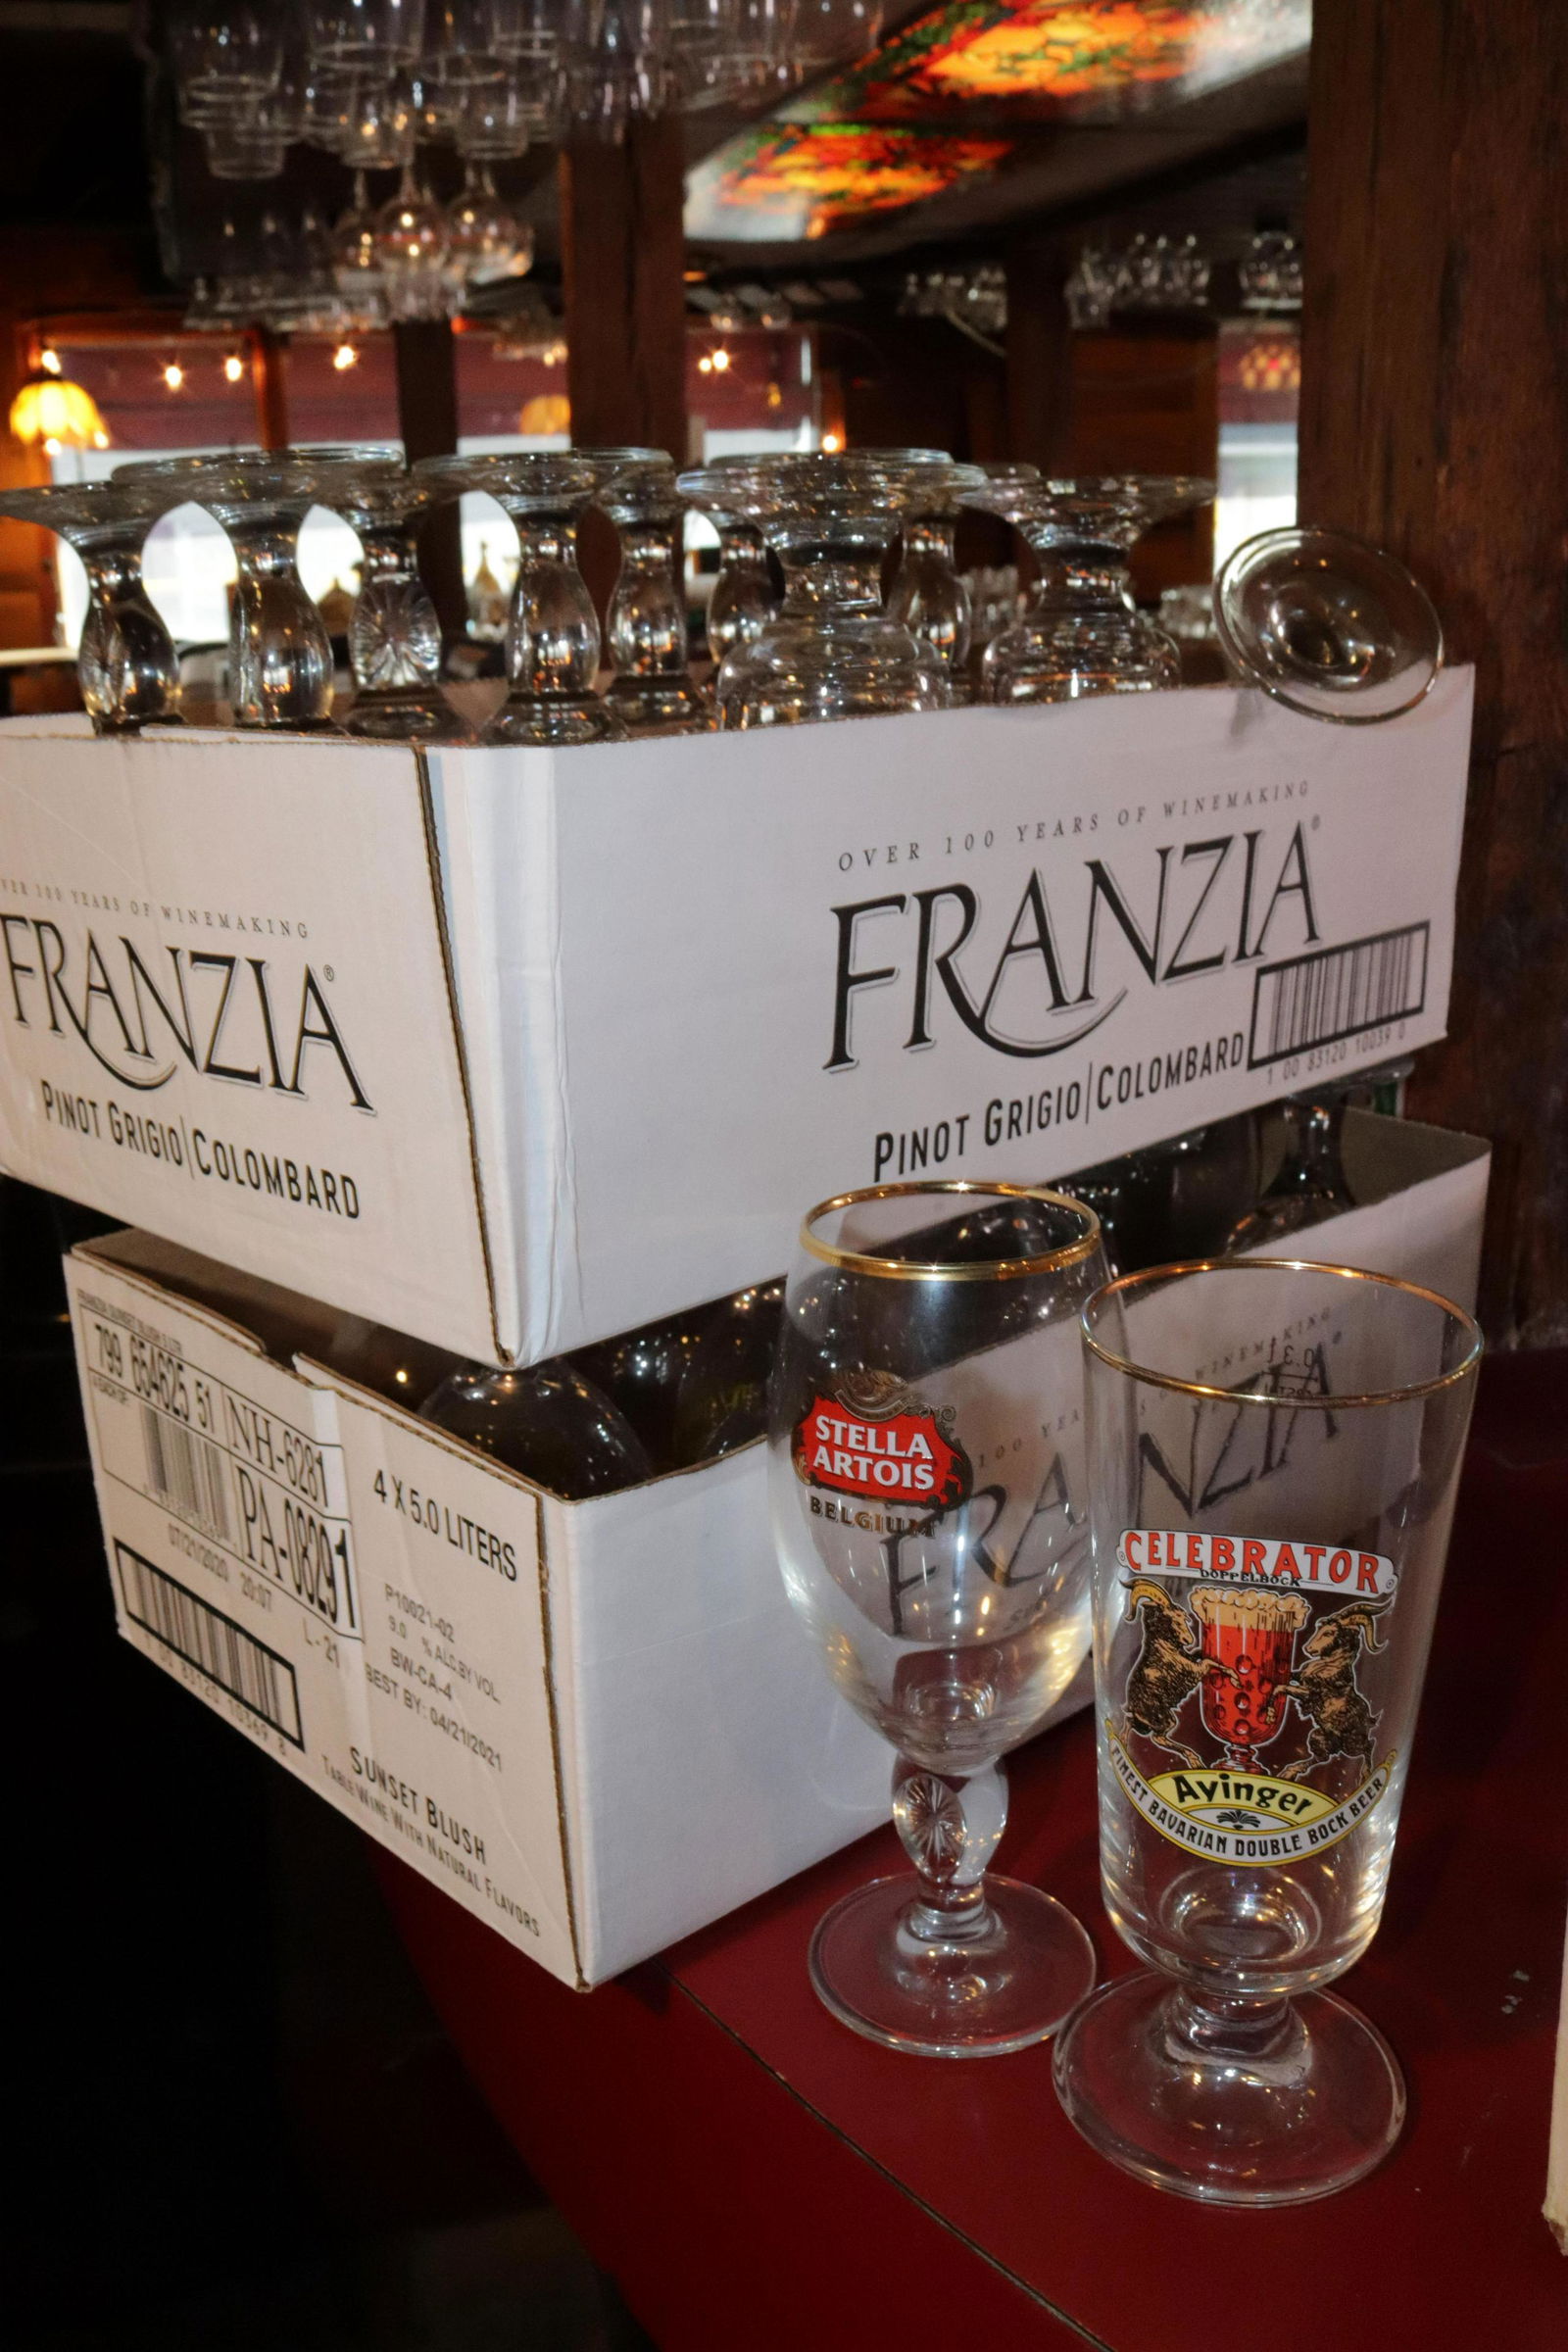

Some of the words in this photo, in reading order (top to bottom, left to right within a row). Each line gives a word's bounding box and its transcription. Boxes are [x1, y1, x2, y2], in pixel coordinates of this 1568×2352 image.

[838, 842, 921, 872] OVER
[945, 829, 996, 856] 100
[1016, 813, 1100, 843] YEARS
[1117, 806, 1147, 826] OF
[1163, 780, 1309, 819] WINEMAKING
[71, 888, 120, 911] YEARS
[129, 900, 149, 917] OF
[161, 906, 310, 939] WINEMAKING
[822, 820, 1323, 1071] FRANZIA
[0, 911, 375, 1114] FRANZIA
[1283, 1056, 1300, 1081] 00
[1307, 1040, 1348, 1072] 83120
[41, 1079, 102, 1139] PINOT
[108, 1101, 183, 1167] GRIGIO
[192, 1127, 361, 1219] COLOMBARD
[873, 1114, 970, 1183] PINOT
[984, 1081, 1080, 1147] GRIGIO
[1097, 1031, 1245, 1111] COLOMBARD
[95, 1323, 123, 1379] 799
[195, 1380, 216, 1435] 51
[227, 1395, 328, 1508] NH-6281
[812, 1445, 935, 1491] ARTOIS
[815, 1414, 934, 1459] STELLA
[236, 1464, 356, 1629] PA-08291
[373, 1469, 388, 1504] 4
[410, 1488, 440, 1536] 5.0
[445, 1506, 517, 1583] LITERS
[809, 1494, 938, 1539] BELGIUM
[1123, 1530, 1380, 1595] CELEBRATOR
[1199, 1568, 1302, 1588] DOPPELBOCK
[365, 1661, 399, 1699] BEST
[429, 1706, 503, 1774] 04/21/2021
[390, 1647, 453, 1701] BW-CA-4
[320, 1753, 356, 1797] TABLE
[355, 1786, 389, 1823] WINE
[391, 1806, 424, 1848] WITH
[425, 1833, 482, 1892] NATURAL
[484, 1876, 541, 1938] FLAVORS
[349, 1745, 419, 1815] SUNSET
[425, 1795, 487, 1866] BLUSH
[1111, 1745, 1149, 1802] FINEST
[1148, 1798, 1228, 1855] BAVARIAN
[1234, 1834, 1303, 1857] DOUBLE
[1306, 1811, 1349, 1845] BOCK
[1348, 1777, 1384, 1818] BEER
[1171, 1771, 1313, 1816] Ayinger
